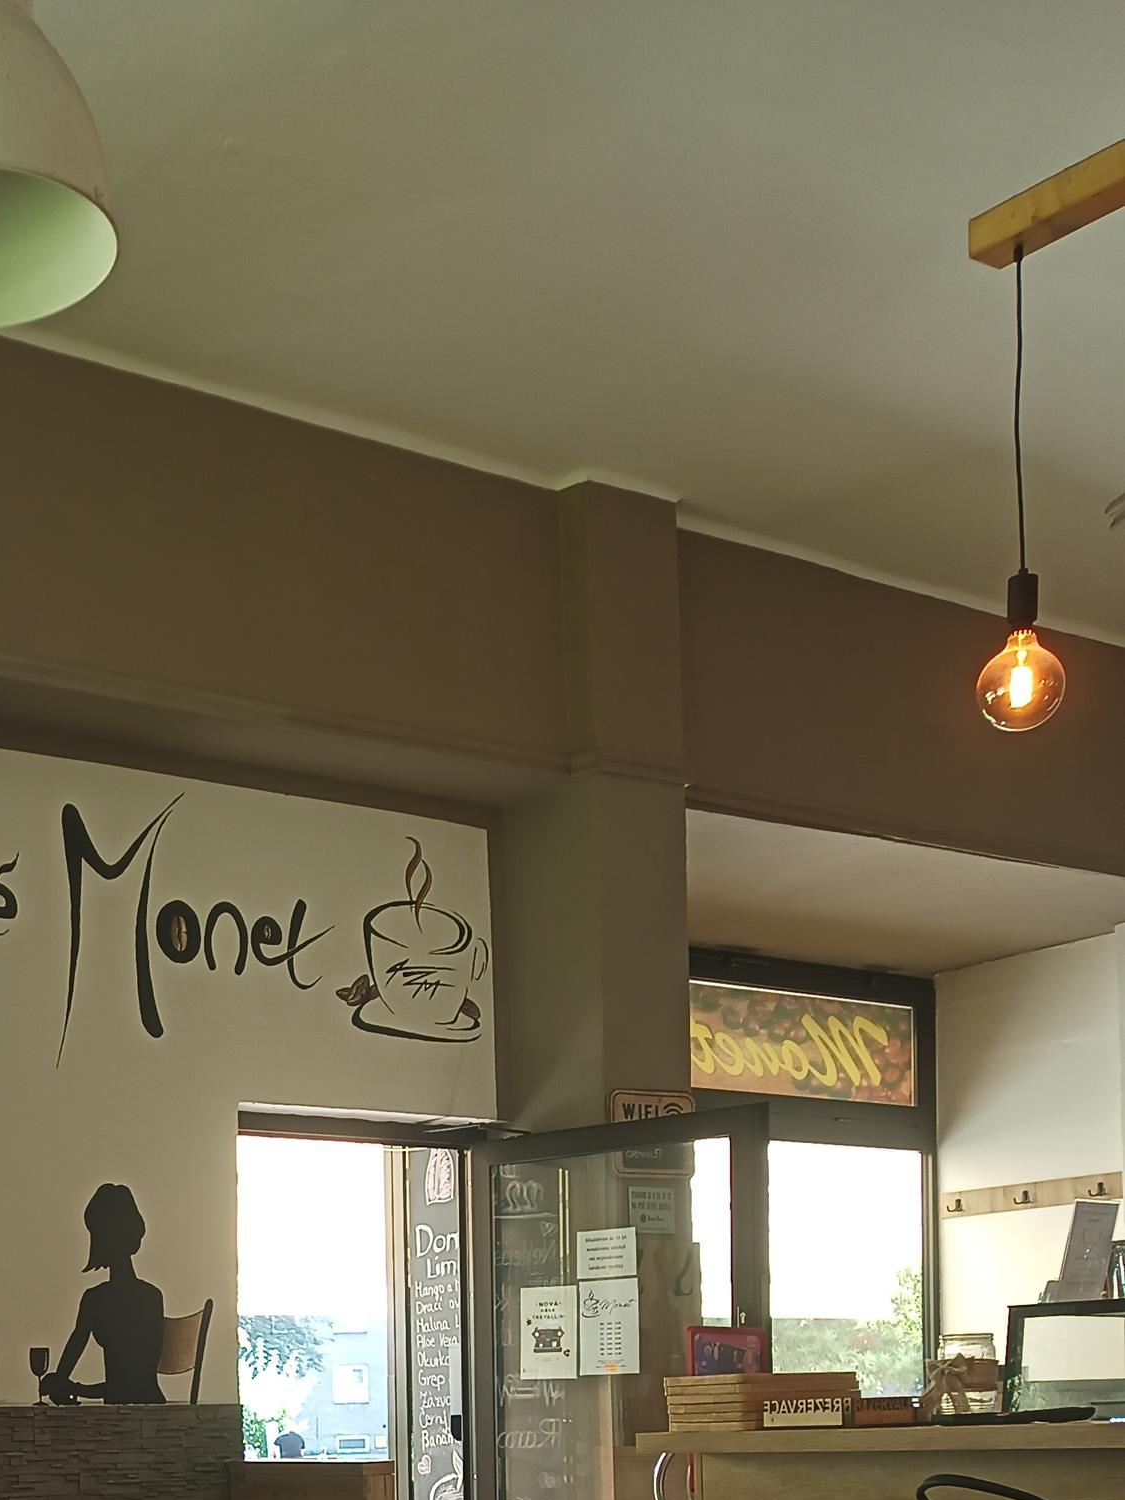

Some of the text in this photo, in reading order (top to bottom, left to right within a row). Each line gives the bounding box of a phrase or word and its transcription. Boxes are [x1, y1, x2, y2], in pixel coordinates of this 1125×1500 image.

[56, 792, 336, 1069] Monet
[622, 1102, 659, 1121] WIFI
[416, 1334, 435, 1349] Aloe
[418, 1369, 446, 1391] Grep
